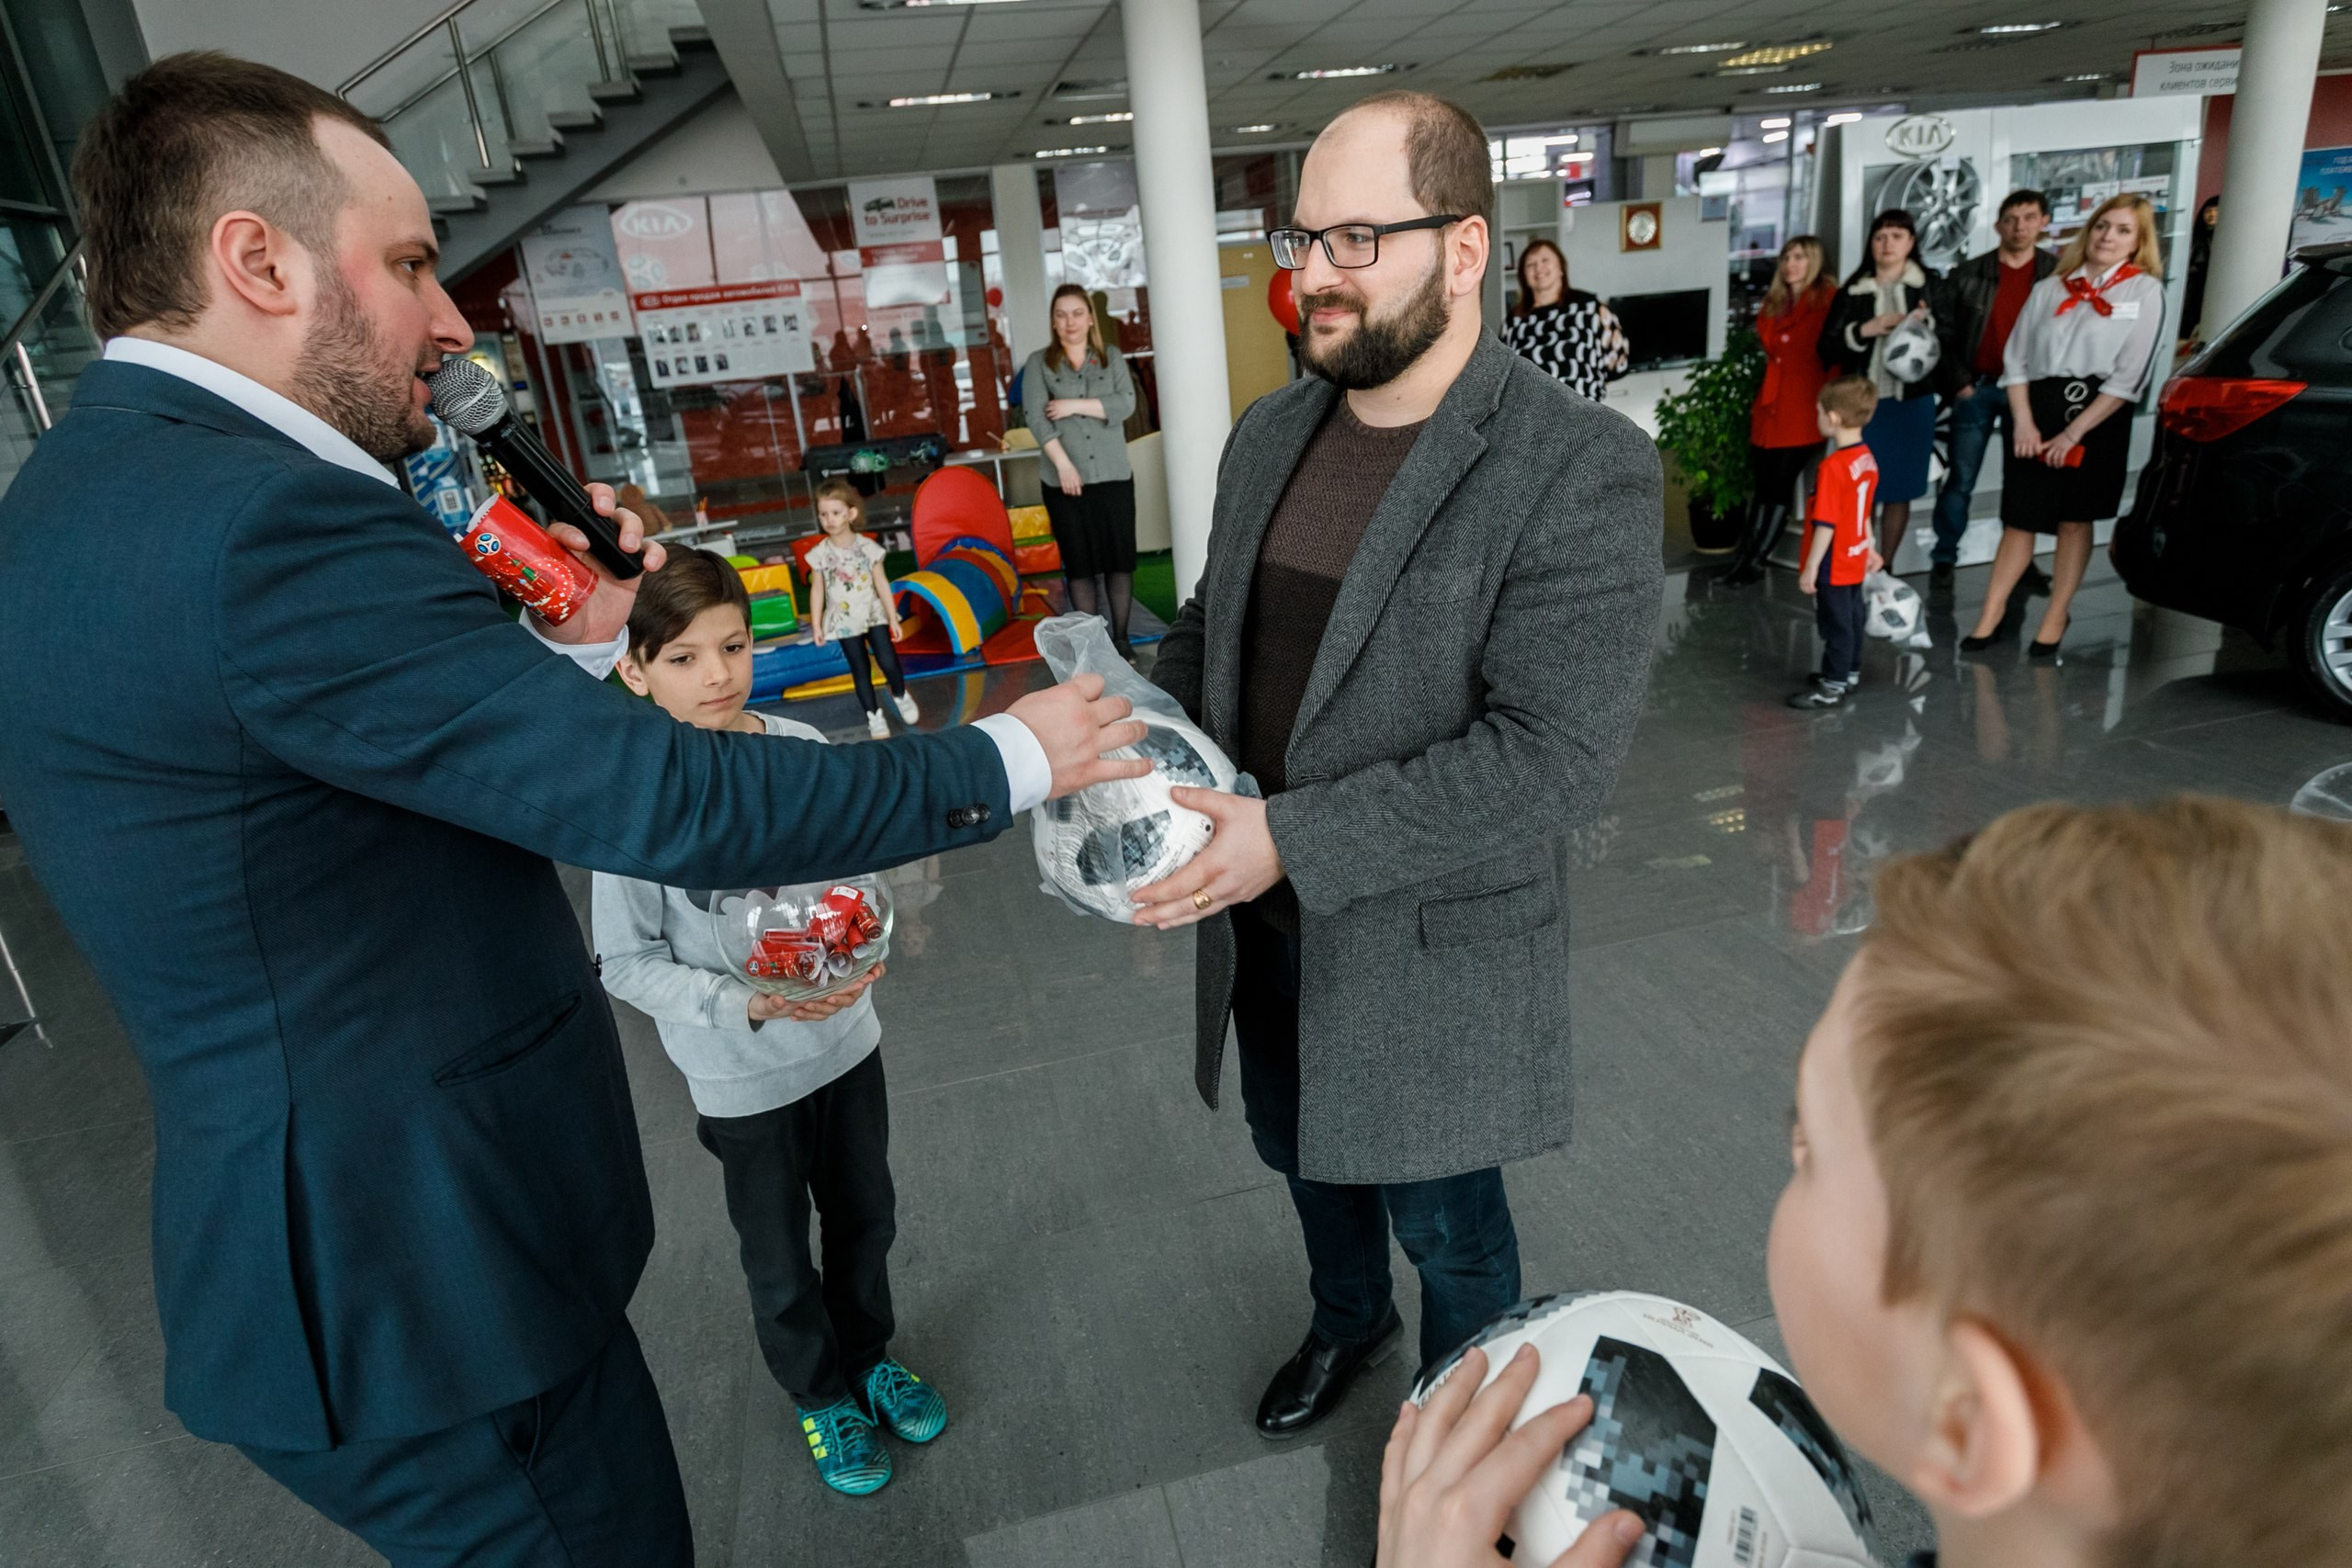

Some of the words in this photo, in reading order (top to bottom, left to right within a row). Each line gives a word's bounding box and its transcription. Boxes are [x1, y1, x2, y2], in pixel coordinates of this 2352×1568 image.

[2168, 61, 2193, 73] Зона
[2195, 59, 2240, 72] ожидани
[2159, 78, 2207, 91] клиентов
[2208, 76, 2237, 89] серви
[1898, 124, 1943, 145] KIA
[896, 197, 928, 209] Drive
[865, 215, 878, 226] to
[880, 211, 931, 225] Surprise
[662, 294, 688, 304] Отдел
[1857, 479, 1871, 537] 1
